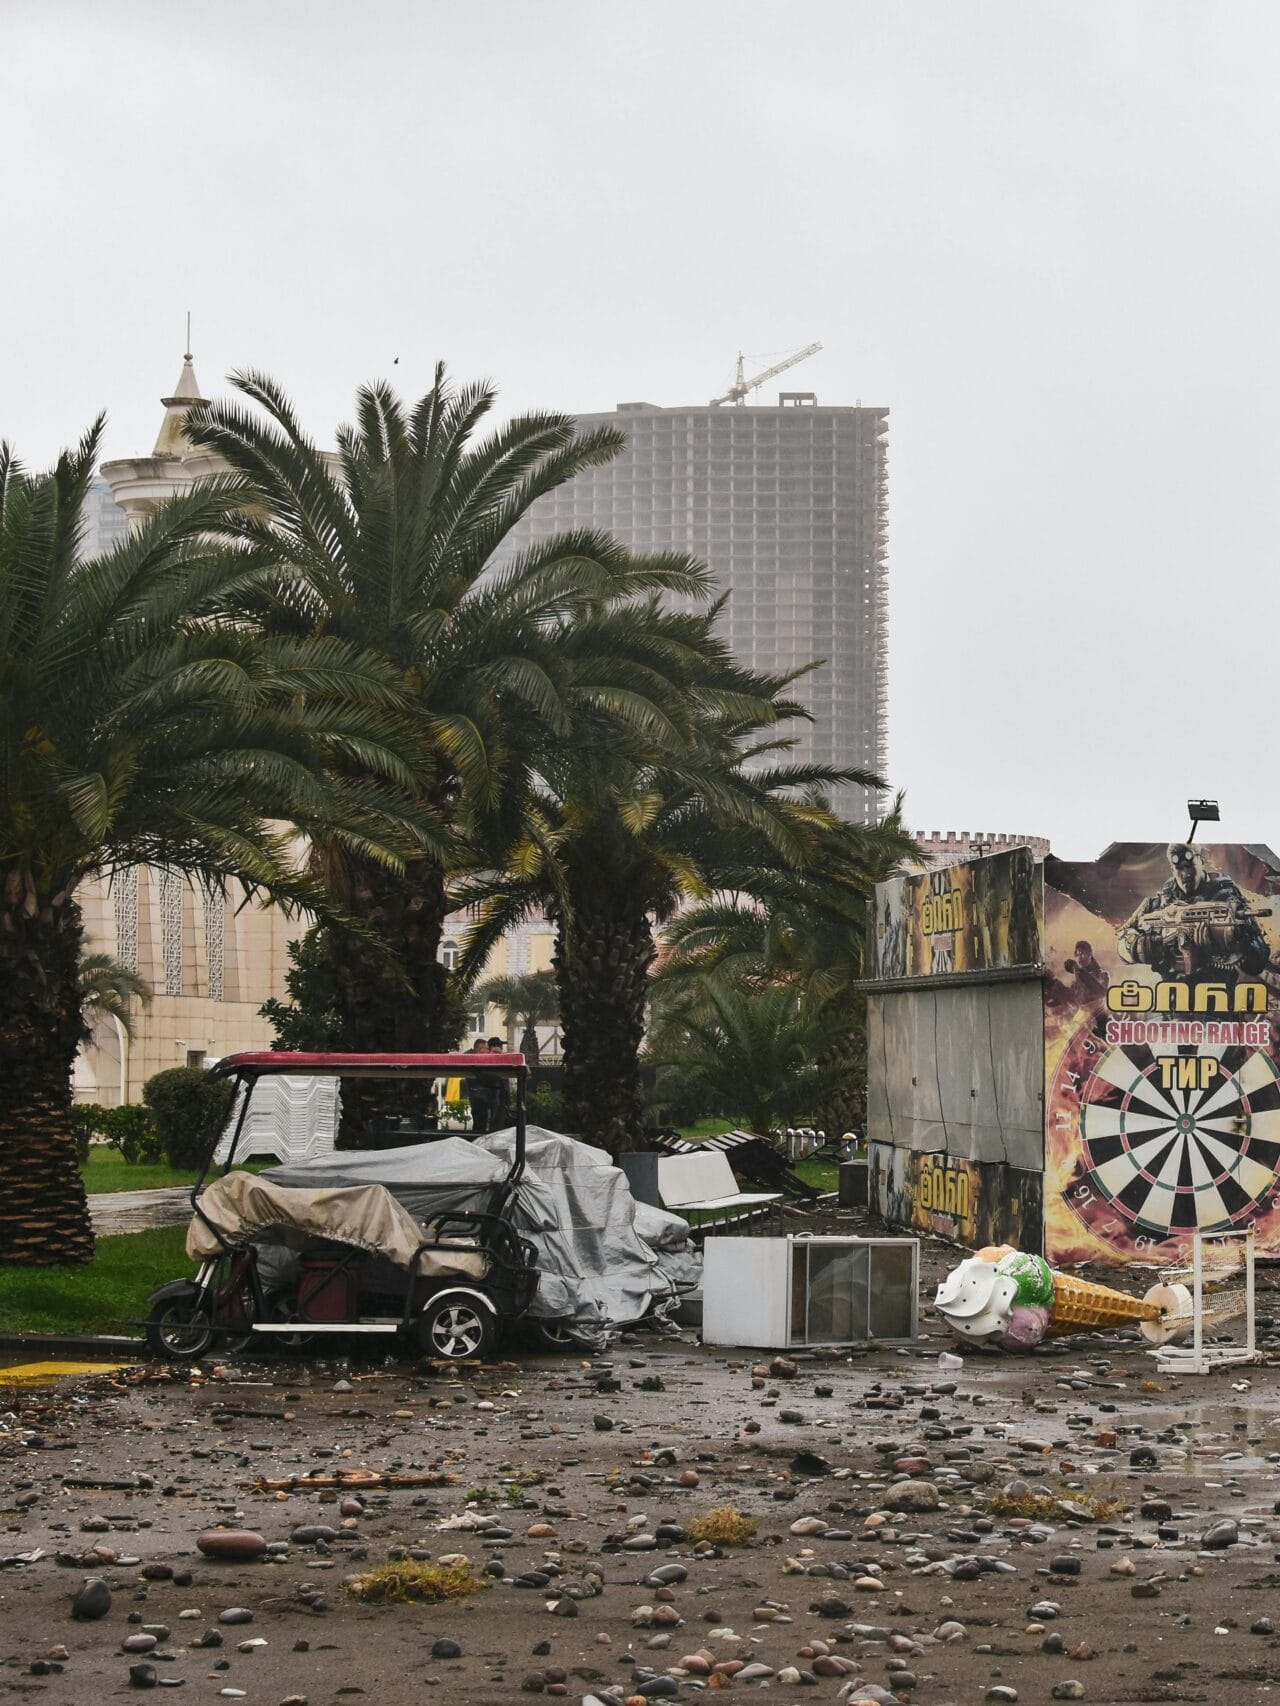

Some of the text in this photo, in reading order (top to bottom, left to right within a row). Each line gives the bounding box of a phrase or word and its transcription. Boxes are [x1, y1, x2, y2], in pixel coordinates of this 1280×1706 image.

[1107, 980, 1268, 1013] ტირი
[1106, 1021, 1269, 1046] SHOOTING RANGE
[1061, 1070, 1080, 1093] 14
[1157, 1056, 1219, 1090] ТИР
[1055, 1111, 1072, 1131] 11
[1073, 1185, 1097, 1210] 16
[1134, 1235, 1157, 1251] 19
